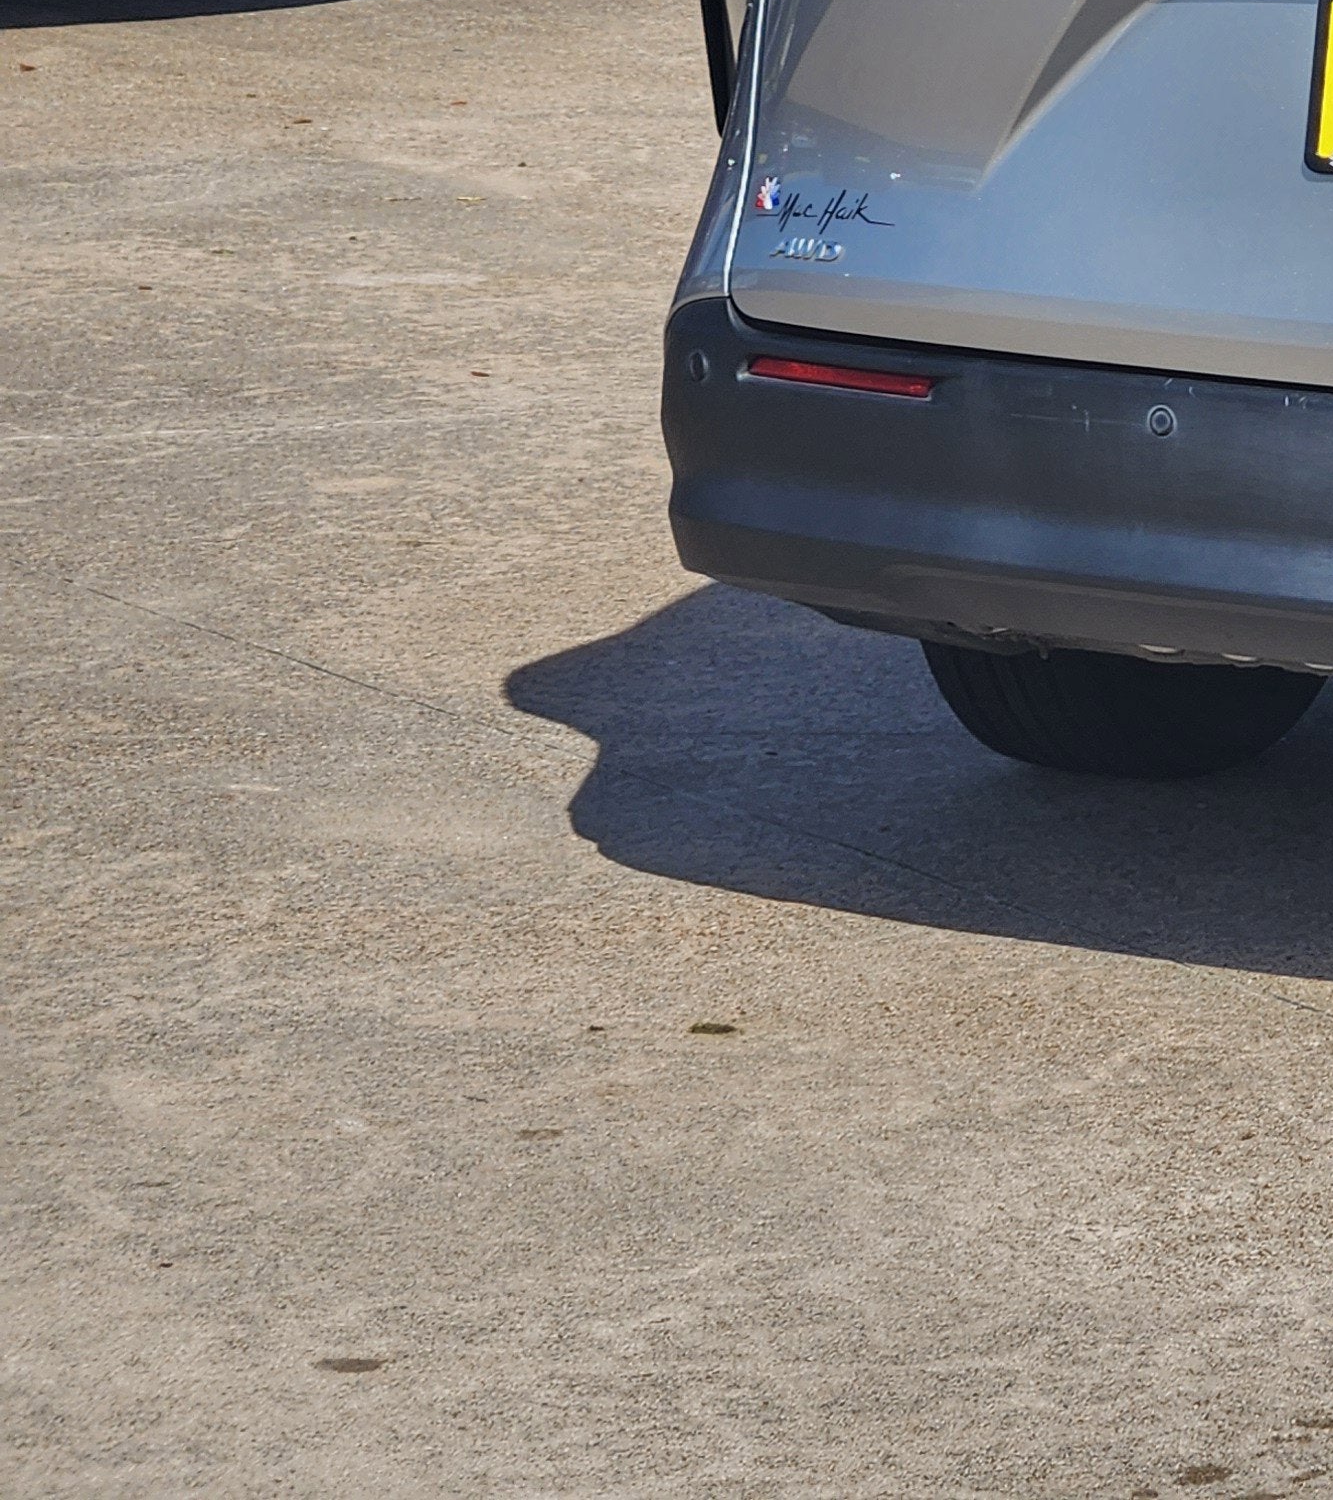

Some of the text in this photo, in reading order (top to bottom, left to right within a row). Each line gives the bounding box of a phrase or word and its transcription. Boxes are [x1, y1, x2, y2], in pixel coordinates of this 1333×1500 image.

[777, 189, 895, 235] Mac Haik
[769, 238, 846, 263] AWD
